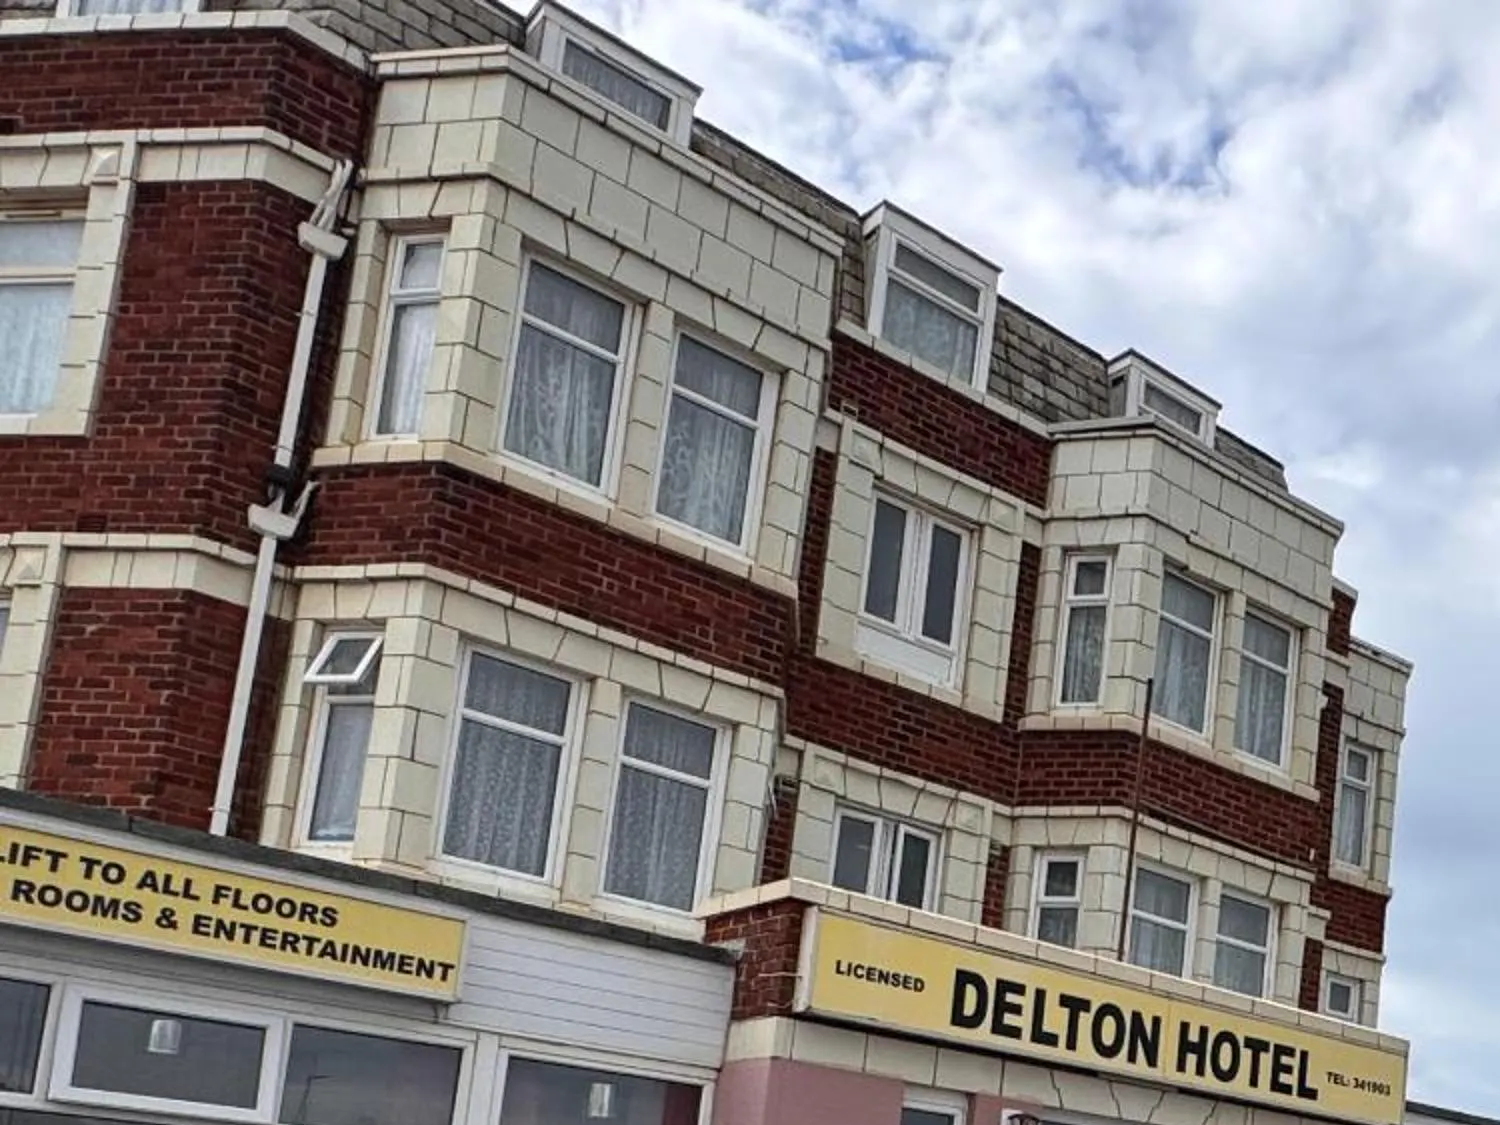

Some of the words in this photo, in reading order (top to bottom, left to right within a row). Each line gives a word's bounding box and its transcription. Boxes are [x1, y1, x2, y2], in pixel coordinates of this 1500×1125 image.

[0, 842, 69, 873] IFT
[80, 856, 127, 885] TO
[136, 870, 200, 900] ALL
[211, 884, 338, 928] FLOORS
[10, 879, 142, 923] ROOMS
[155, 908, 179, 931] &
[191, 914, 456, 982] ENTERTAINMENT
[835, 960, 925, 992] LICENSED
[950, 968, 1163, 1068] DELTON
[1175, 1021, 1318, 1100] HOTEL
